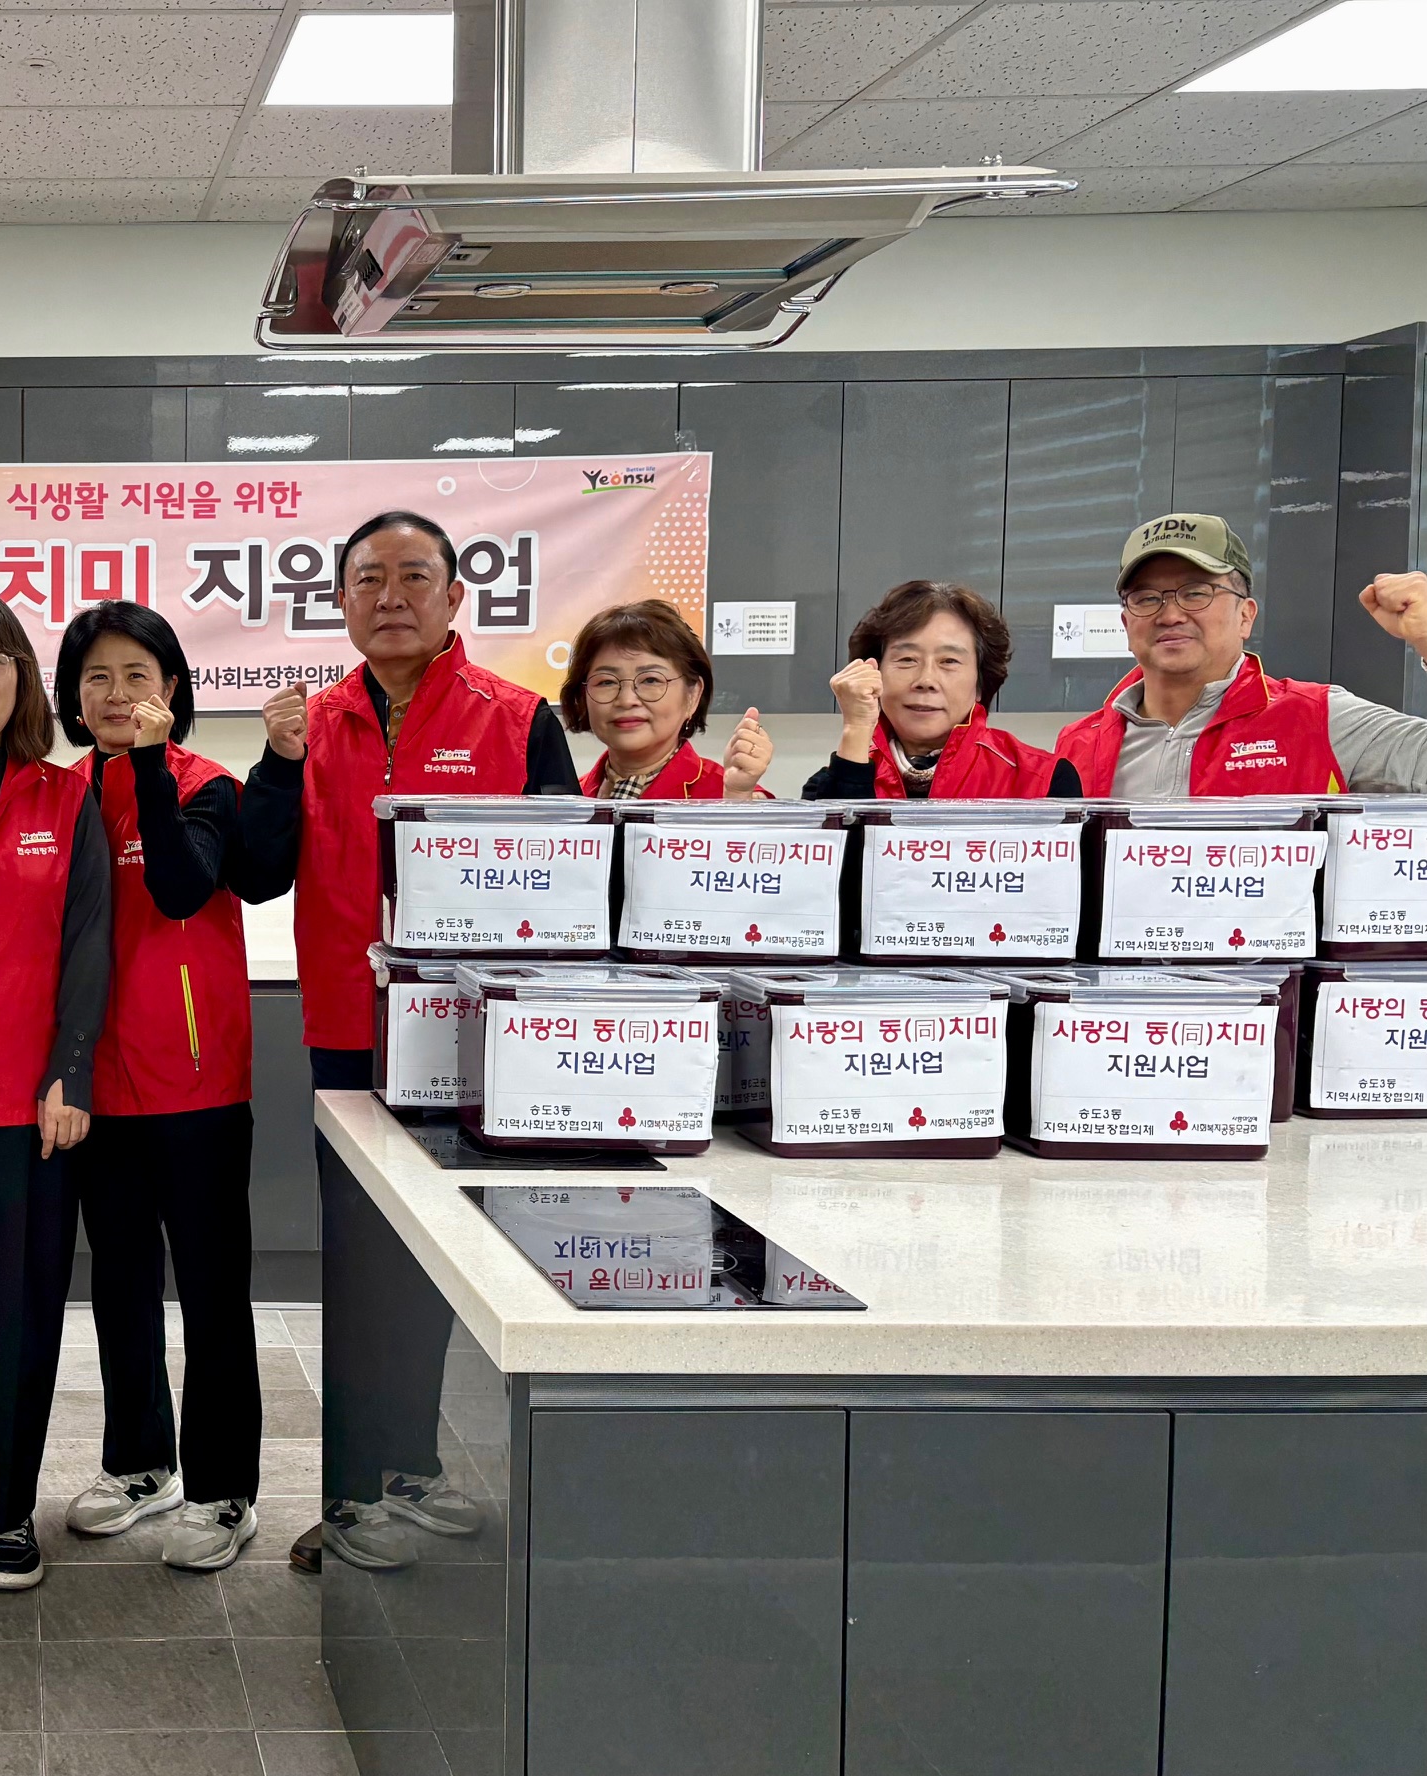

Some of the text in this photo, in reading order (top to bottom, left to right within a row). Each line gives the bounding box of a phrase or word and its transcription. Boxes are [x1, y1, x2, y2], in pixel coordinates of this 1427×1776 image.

[582, 469, 655, 490] Yeonsu
[7, 482, 109, 521] 식생활
[121, 481, 222, 519] 지원을
[234, 481, 302, 518] 위한
[1143, 519, 1197, 540] 17Div
[190, 537, 532, 631] 지원업
[1347, 829, 1412, 850] 사랑의
[411, 838, 600, 861] 사랑의 동(同)치미
[642, 838, 832, 865] 사랑의 동(同)치미
[882, 840, 1074, 863] 사랑의 동(同)치미
[1123, 845, 1317, 870] 사랑의 동(同)치미
[460, 869, 550, 890] 지원사업
[690, 871, 780, 894] 지원사업
[932, 871, 1024, 893] 지원사업
[1172, 876, 1264, 897] 지원사업
[1369, 911, 1406, 921] 송도3동
[436, 918, 474, 929] 송도3동
[664, 920, 701, 931] 송도3동
[906, 922, 945, 933] 송도3동
[1338, 925, 1427, 935] 지역사회보장협의
[406, 931, 502, 942] 지역사회보장협의체
[537, 931, 595, 941] 사회복지공동모금회
[1145, 927, 1184, 937] 송도3동
[631, 931, 730, 947] 지역사회보장협의체
[765, 936, 824, 947] 사회복지공동모금회
[875, 936, 974, 946] 지역사회보장협의체
[1009, 935, 1068, 945] 사회복지공동모금회
[1248, 939, 1305, 949] 사회복지공동모금회
[1114, 941, 1213, 951] 지역사회보장협의체
[1335, 998, 1404, 1019] 사랑의
[504, 1018, 577, 1041] 사랑의
[593, 1019, 708, 1043] 동(同)치미
[790, 1017, 996, 1044] 사랑의 동(同)치미
[1053, 1020, 1264, 1046] 사랑의 동(同)치미
[557, 1051, 654, 1075] 지원사업
[845, 1051, 942, 1076] 지원사업
[1108, 1054, 1208, 1078] 지원사업
[1359, 1079, 1396, 1089] 송도3동
[1326, 1091, 1423, 1103] 지역사회보장협의체
[530, 1105, 571, 1116] 송도3동
[819, 1109, 861, 1120] 송도3동
[1079, 1109, 1121, 1120] 송도3동
[498, 1118, 602, 1131] 지역사회보장협의체
[639, 1120, 702, 1130] 사회복지공동모금회
[930, 1114, 994, 1128] 사회복지공동모금회
[787, 1123, 893, 1135] 지역사회보장협의체
[1044, 1122, 1153, 1135] 지역사회보장협의체
[1192, 1124, 1257, 1135] 사회복지공동모금회
